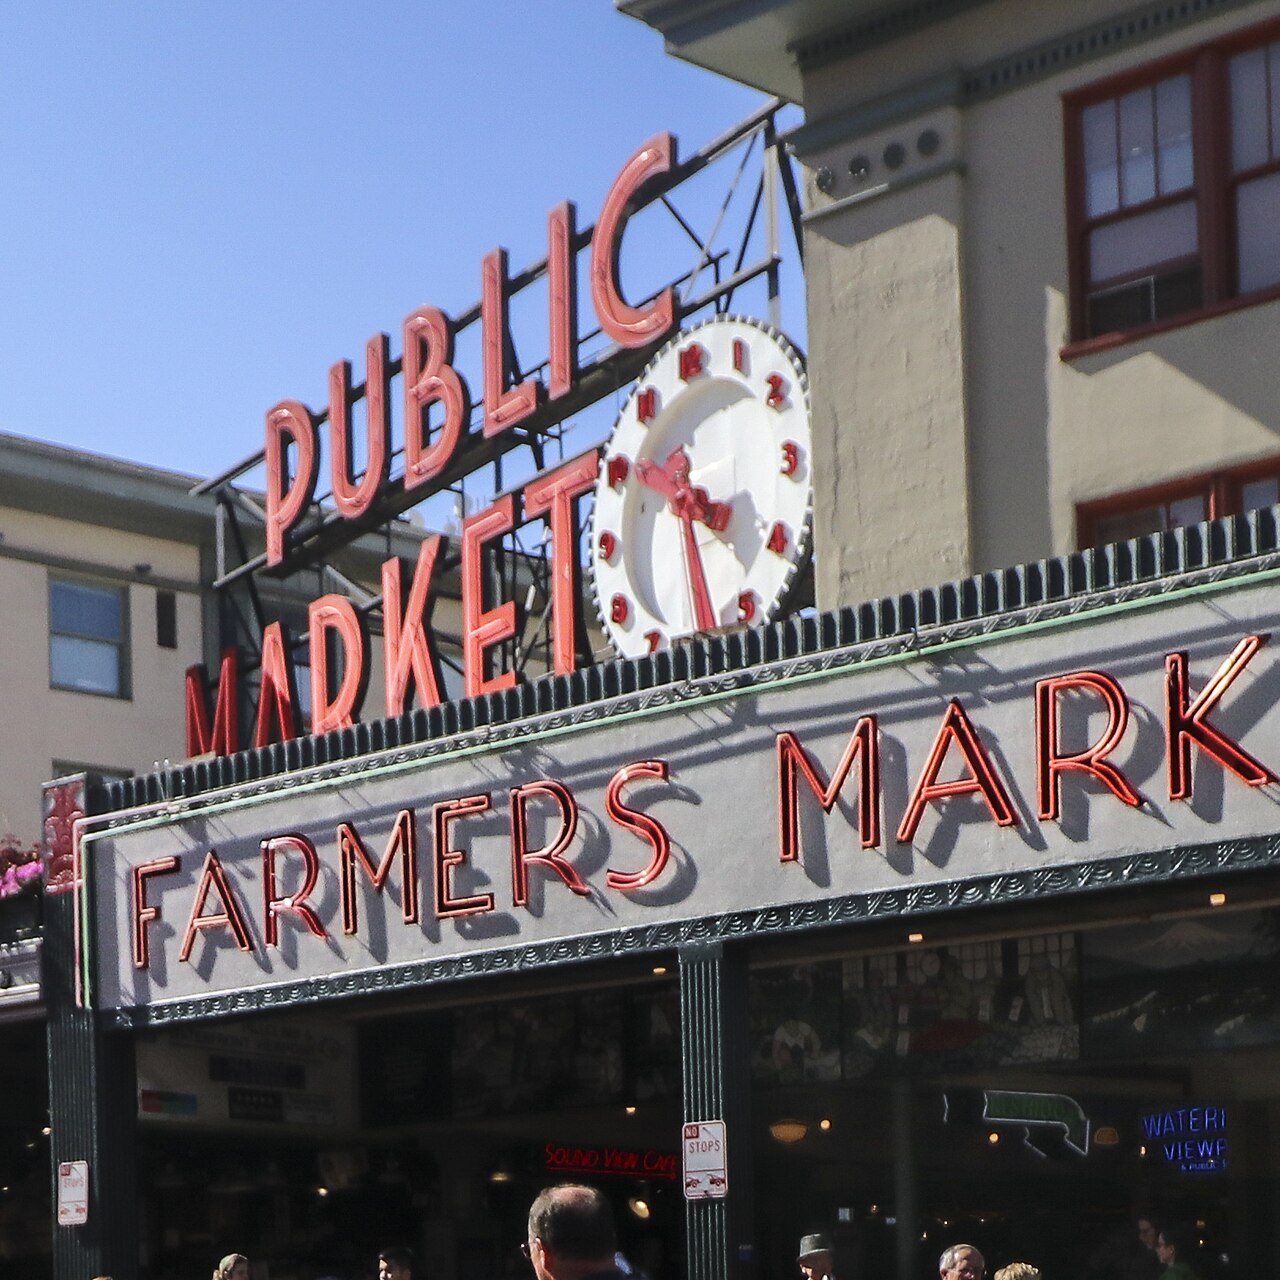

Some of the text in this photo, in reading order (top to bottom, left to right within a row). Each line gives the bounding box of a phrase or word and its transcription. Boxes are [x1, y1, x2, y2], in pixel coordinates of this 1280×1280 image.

[265, 132, 676, 567] PUBLIC
[185, 448, 602, 757] MARKET
[131, 759, 671, 970] FARMERS
[545, 1143, 599, 1166] SOUND
[604, 1148, 640, 1169] VIEW
[685, 1126, 698, 1138] NO
[689, 1140, 720, 1154] STOPS
